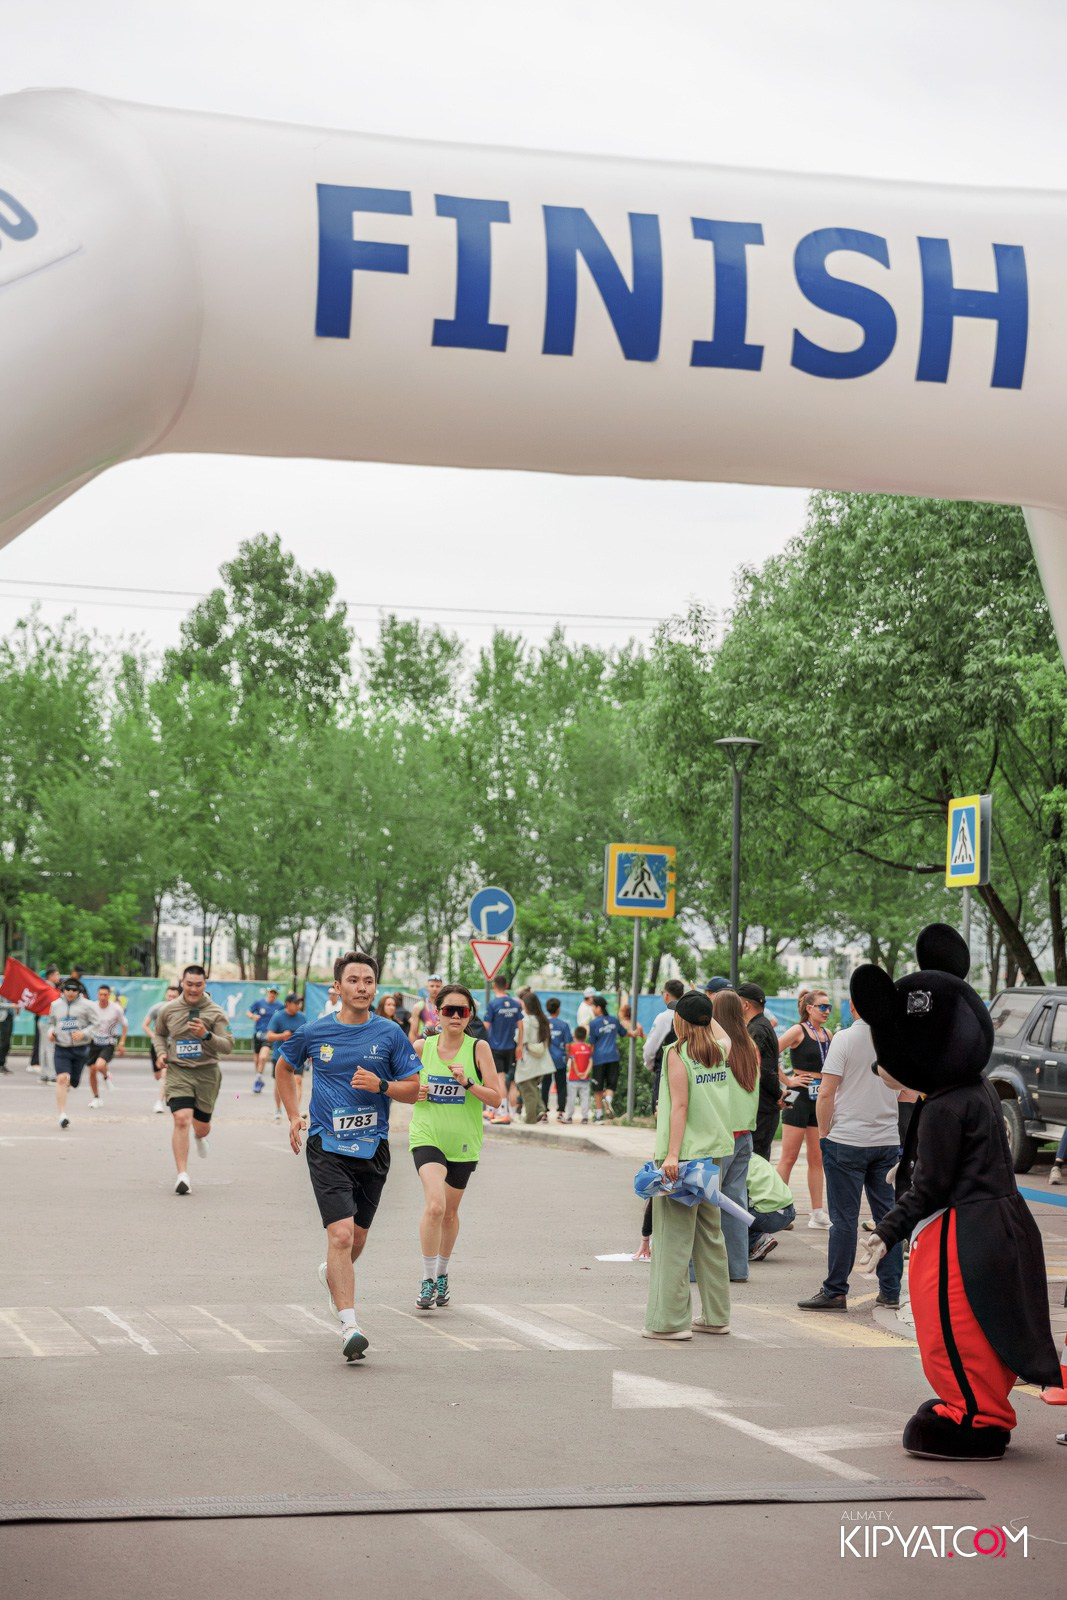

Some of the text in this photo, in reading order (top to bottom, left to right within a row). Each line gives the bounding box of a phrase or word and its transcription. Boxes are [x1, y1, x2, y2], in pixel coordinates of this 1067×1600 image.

[314, 182, 1029, 389] FINISH
[434, 1085, 459, 1095] 1181
[340, 1114, 372, 1129] 1783
